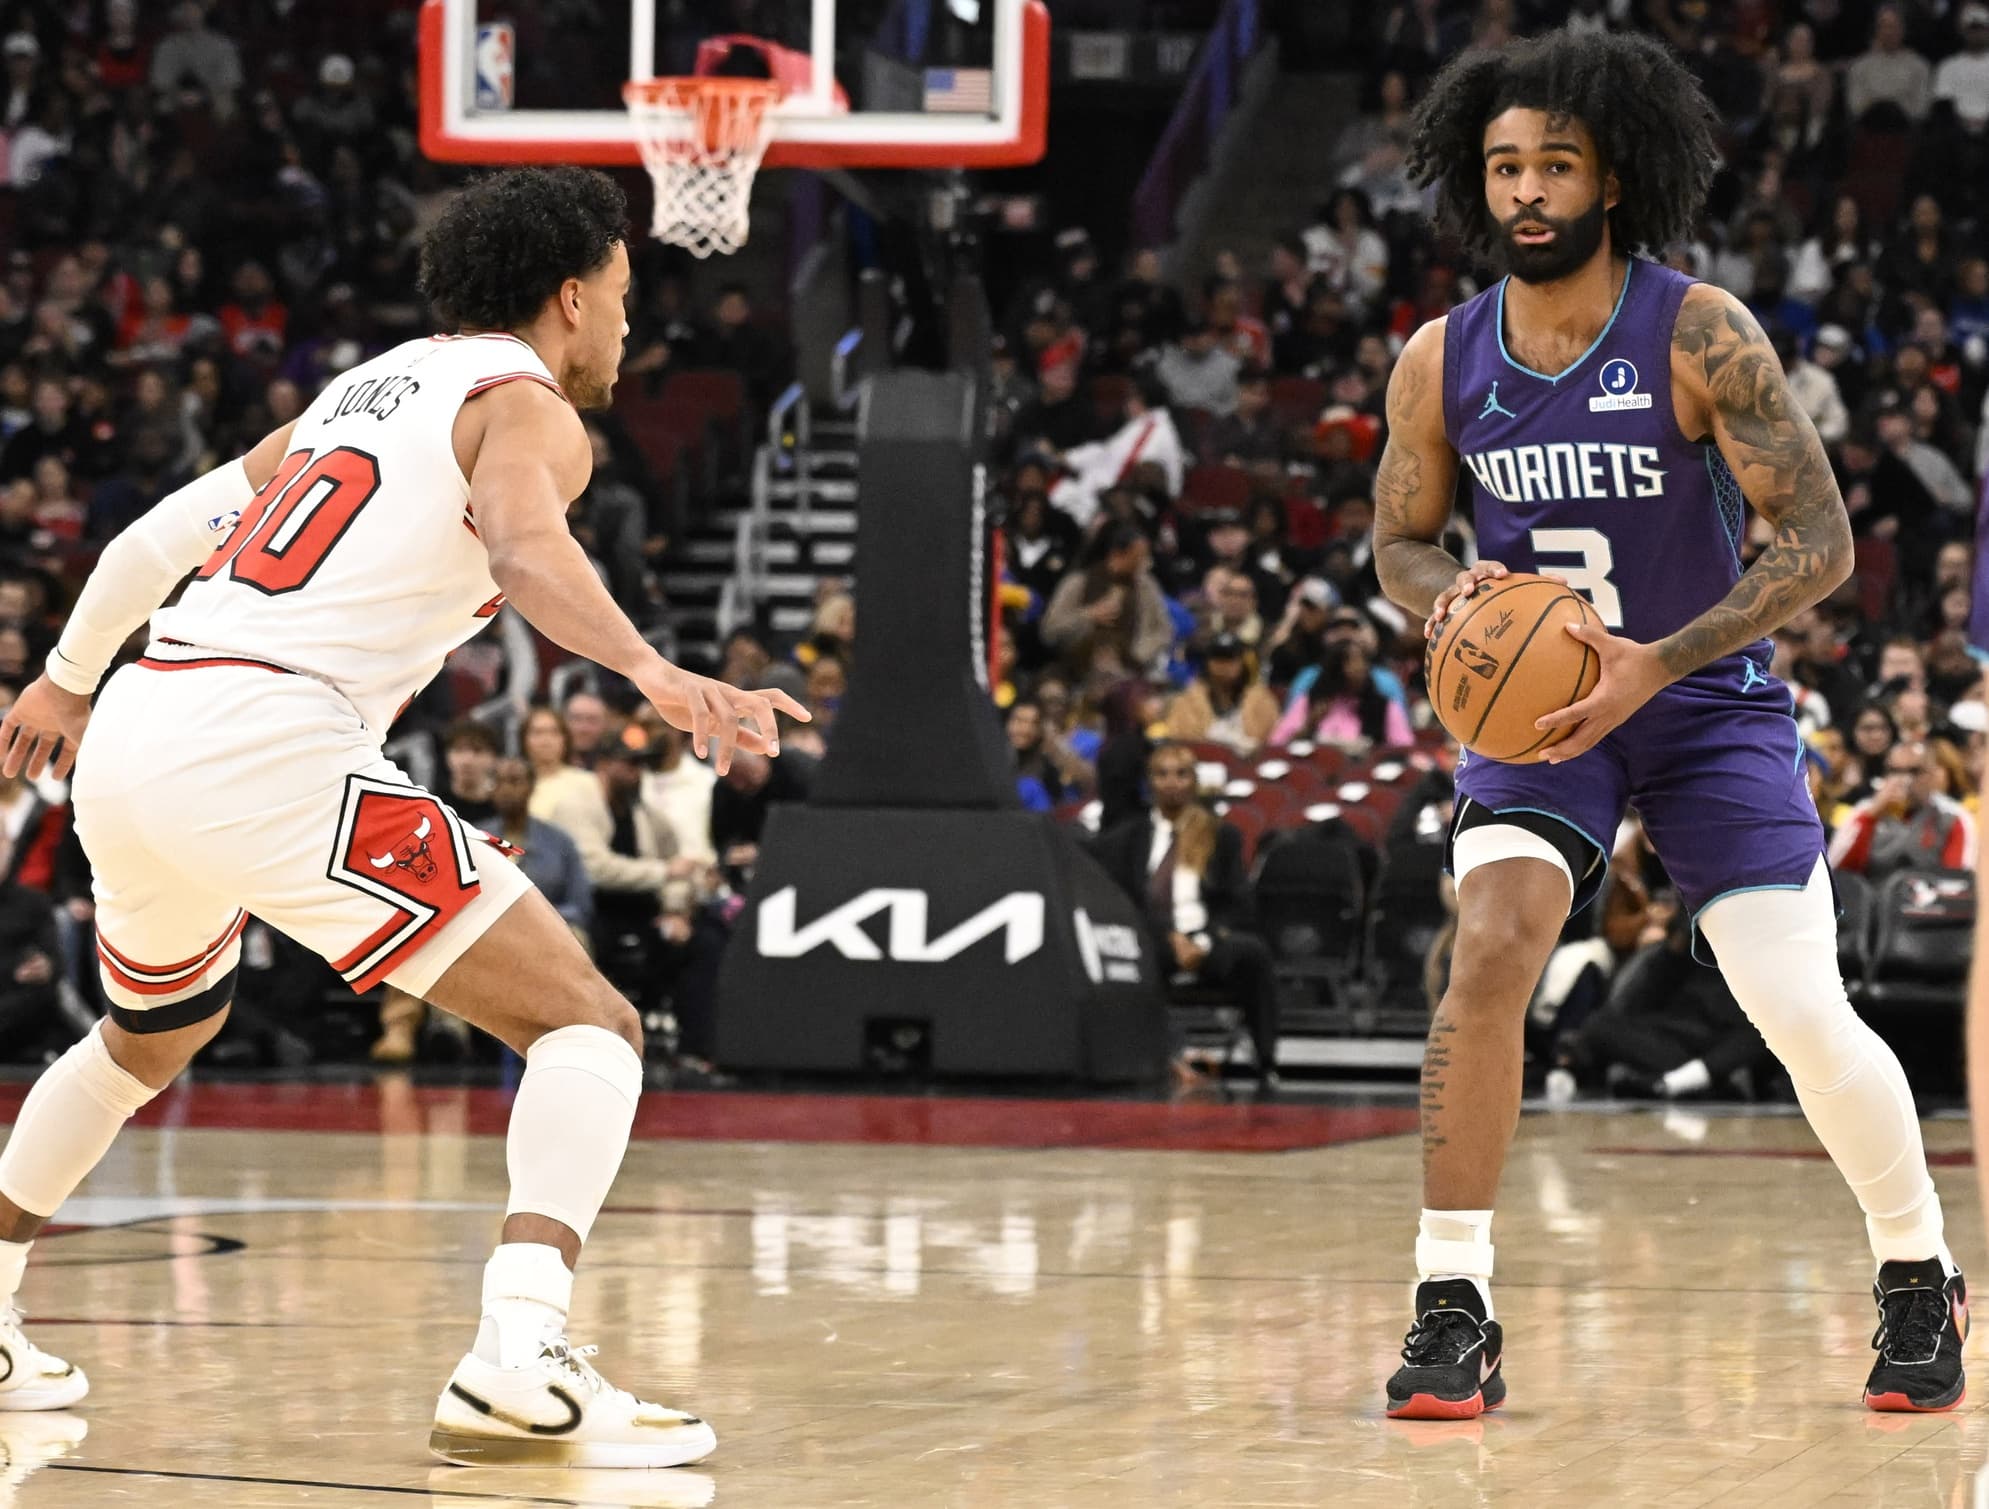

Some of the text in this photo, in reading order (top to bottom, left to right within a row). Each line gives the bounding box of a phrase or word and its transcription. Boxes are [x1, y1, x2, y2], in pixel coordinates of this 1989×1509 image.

[322, 376, 421, 425] JONES
[1591, 396, 1651, 410] Judi Health
[1464, 442, 1668, 502] HORNETS
[1529, 527, 1624, 629] 3
